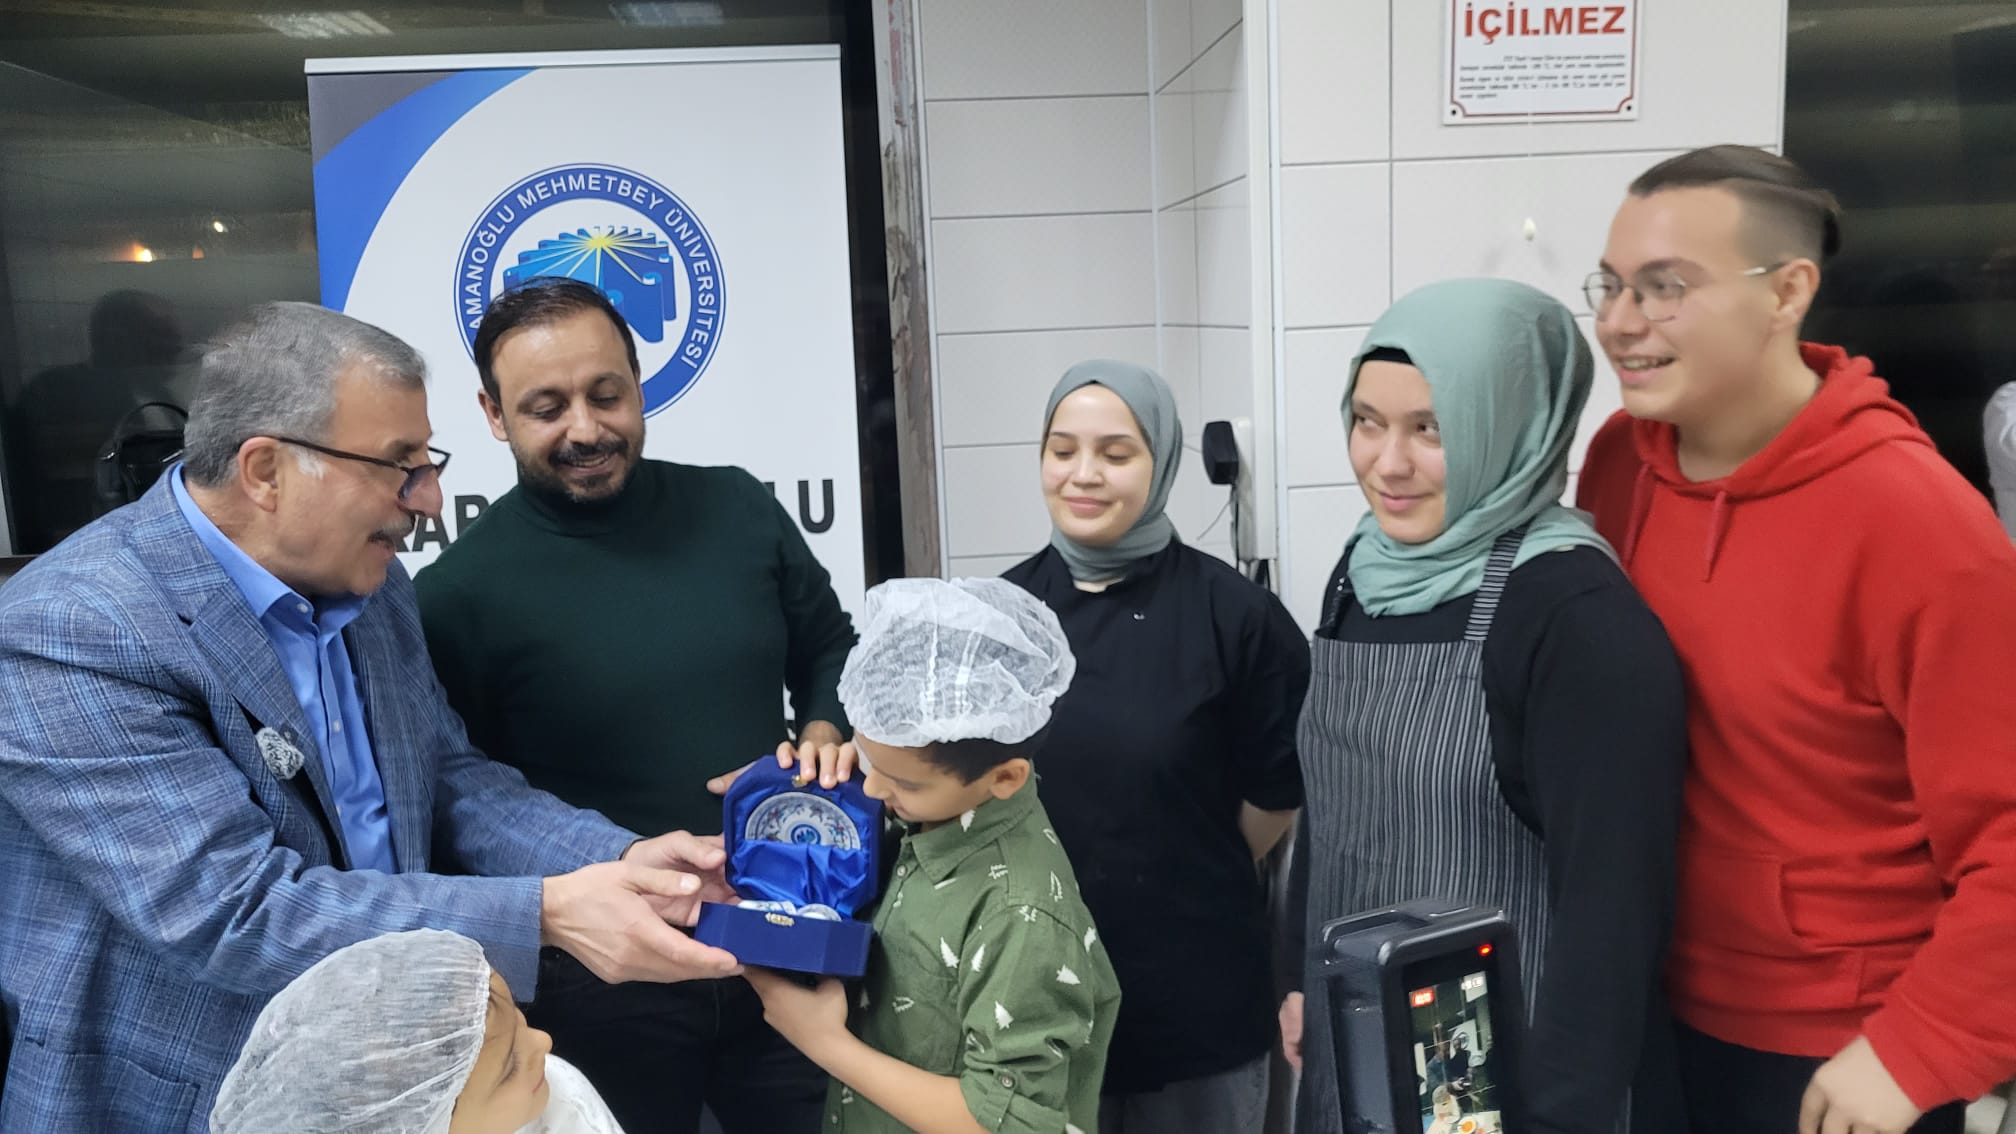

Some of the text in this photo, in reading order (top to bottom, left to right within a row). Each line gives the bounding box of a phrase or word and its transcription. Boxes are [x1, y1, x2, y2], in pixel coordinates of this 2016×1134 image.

[1464, 1, 1626, 45] İÇİLMEZ
[465, 204, 516, 329] AMANOĞLU
[517, 172, 664, 210] MEHMETBEY
